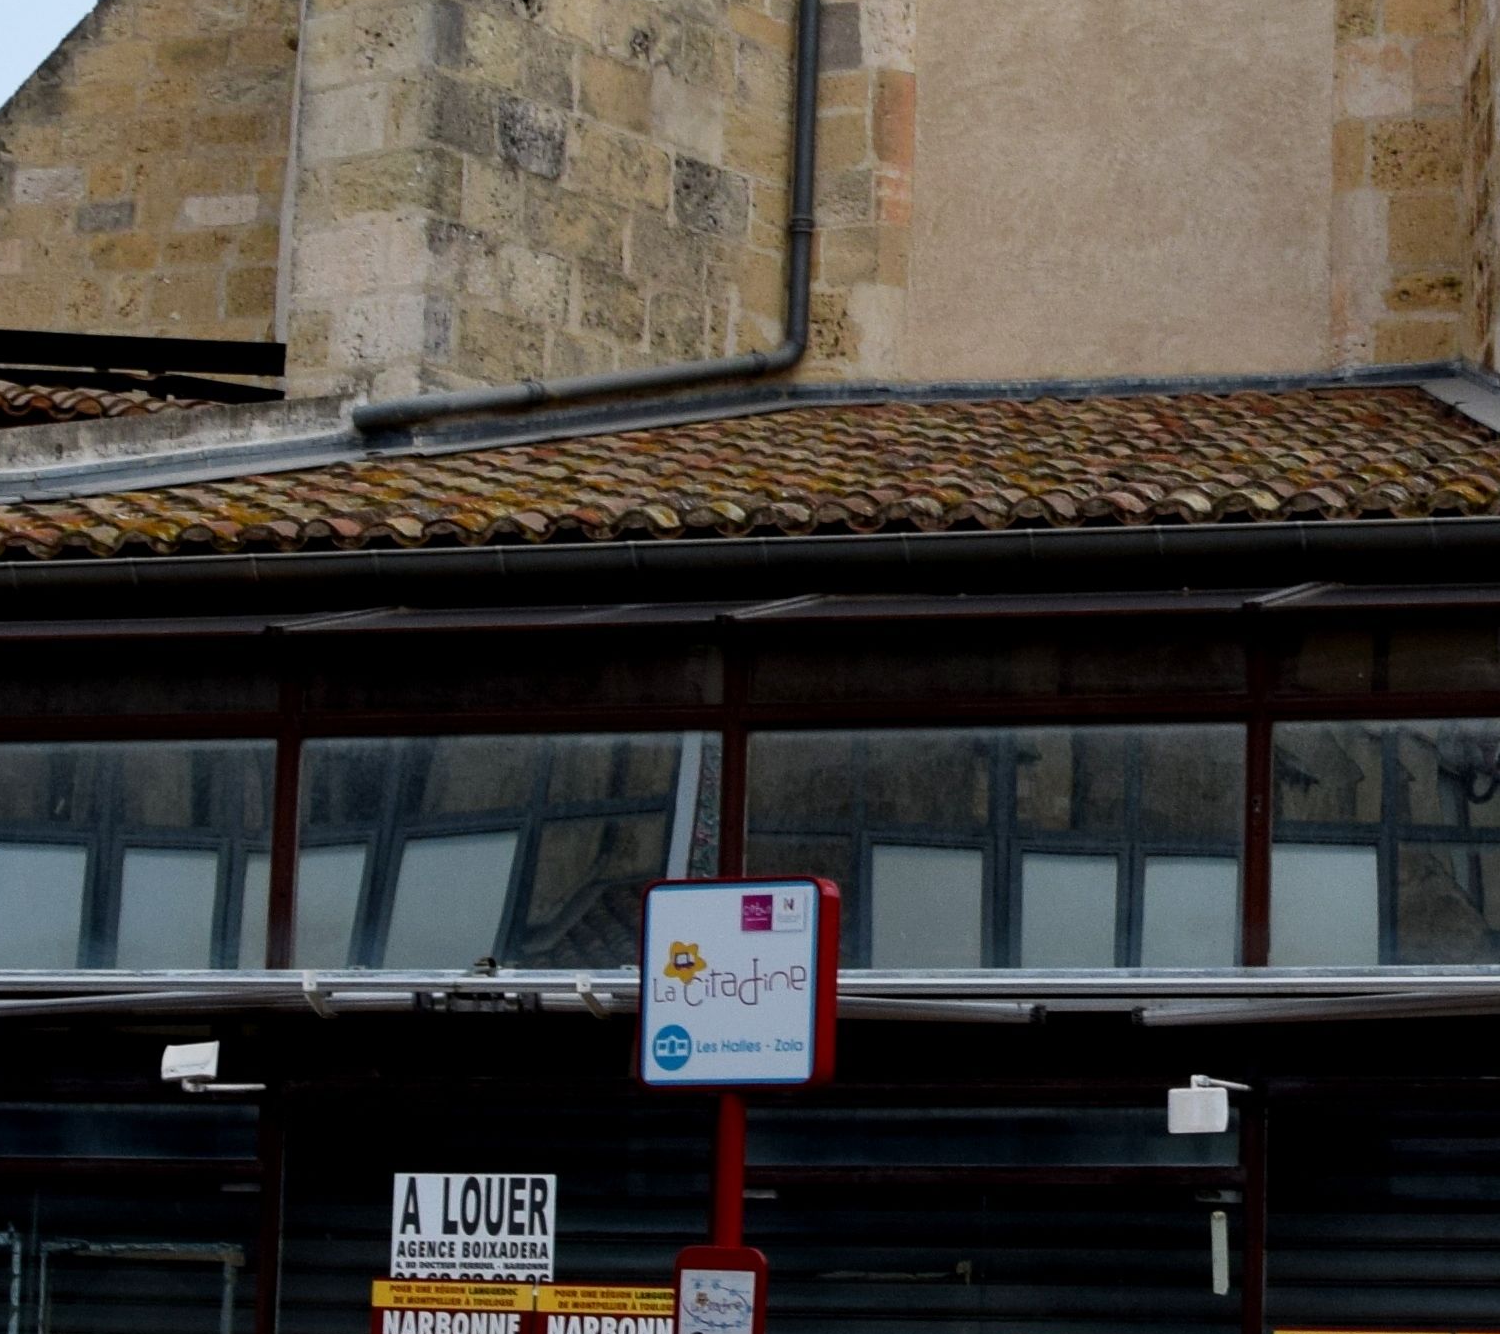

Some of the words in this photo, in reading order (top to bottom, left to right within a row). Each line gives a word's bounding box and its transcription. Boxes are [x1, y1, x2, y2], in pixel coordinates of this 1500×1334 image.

[653, 978, 676, 1003] La
[684, 958, 806, 1006] Citadine
[697, 1039, 716, 1053] Les
[722, 1040, 760, 1052] Halles
[774, 1039, 803, 1052] Zola
[400, 1176, 421, 1235] A
[442, 1176, 549, 1236] LOUER
[397, 1241, 455, 1258] AGENCE
[462, 1241, 549, 1259] BOIXADERA
[390, 1285, 412, 1293] POUR
[468, 1287, 517, 1295] LANGUEDOC
[581, 1290, 597, 1298] UNE
[407, 1296, 461, 1305] MONTPELLIER
[473, 1298, 514, 1306] TOULOUSE
[572, 1301, 627, 1309] MONTPELLIER
